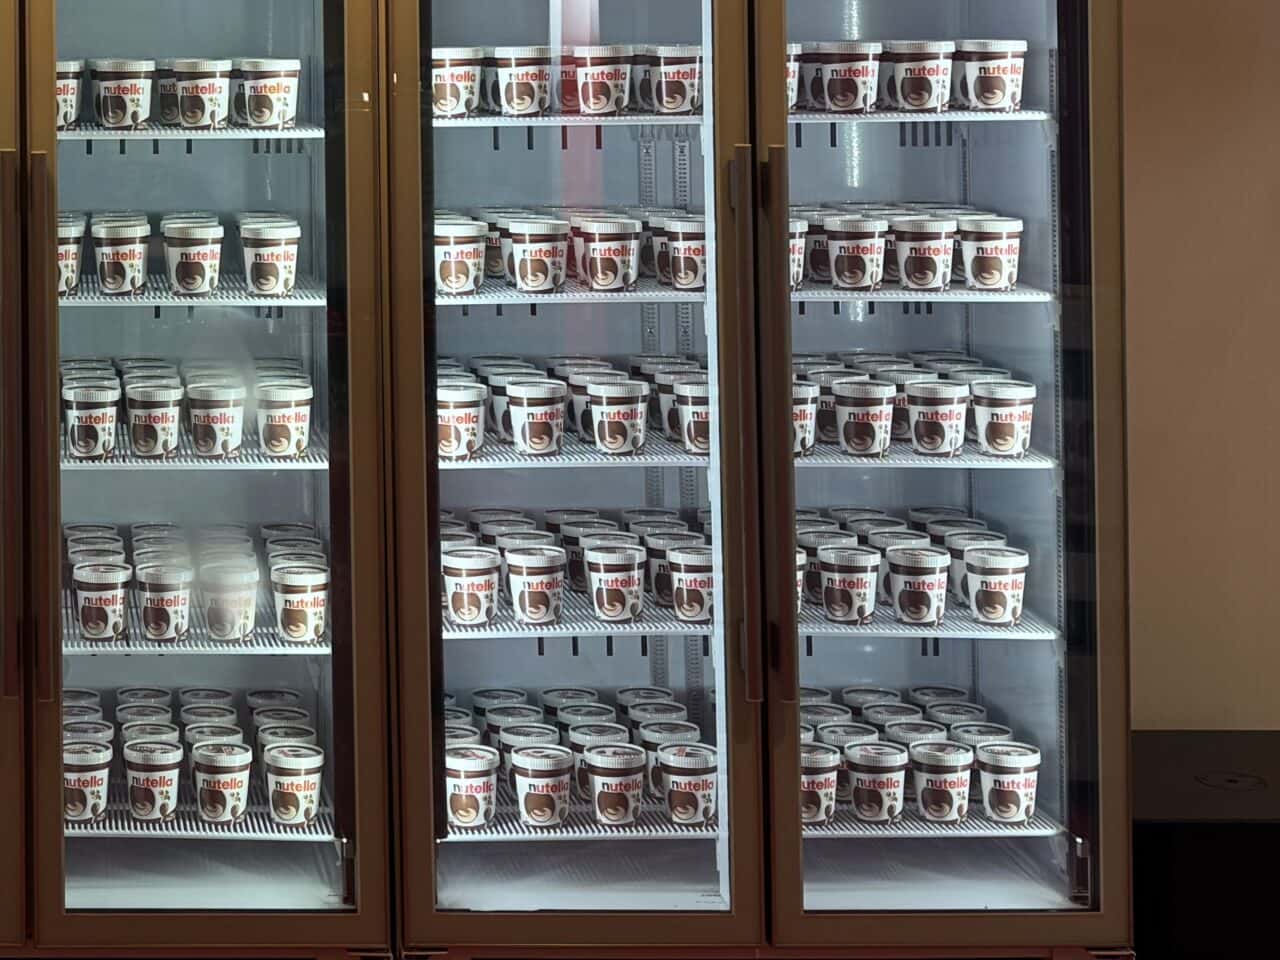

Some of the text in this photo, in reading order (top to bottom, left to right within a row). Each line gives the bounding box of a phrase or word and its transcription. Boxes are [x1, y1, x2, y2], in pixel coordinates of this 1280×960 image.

[585, 69, 627, 81] nutella
[104, 83, 143, 95] nutella
[182, 84, 222, 95] nutella
[250, 84, 290, 95] nutella
[592, 246, 634, 257] nutella
[839, 243, 881, 255] nutella
[102, 251, 143, 261] nutella
[181, 251, 219, 261] nutella
[73, 413, 114, 424] nutella
[134, 413, 174, 424] nutella
[194, 413, 234, 424] nutella
[601, 409, 643, 420] nutella
[919, 410, 961, 422] nutella
[523, 578, 563, 590] nutella
[599, 576, 640, 588] nutella
[827, 576, 870, 589] nutella
[84, 596, 124, 607] nutella
[146, 595, 186, 607] nutella
[132, 775, 172, 787] nutella
[202, 778, 243, 790] nutella
[275, 780, 316, 792] nutella
[529, 781, 568, 793] nutella
[602, 779, 641, 790] nutella
[672, 778, 713, 790] nutella
[857, 777, 900, 789] nutella
[926, 777, 968, 789] nutella
